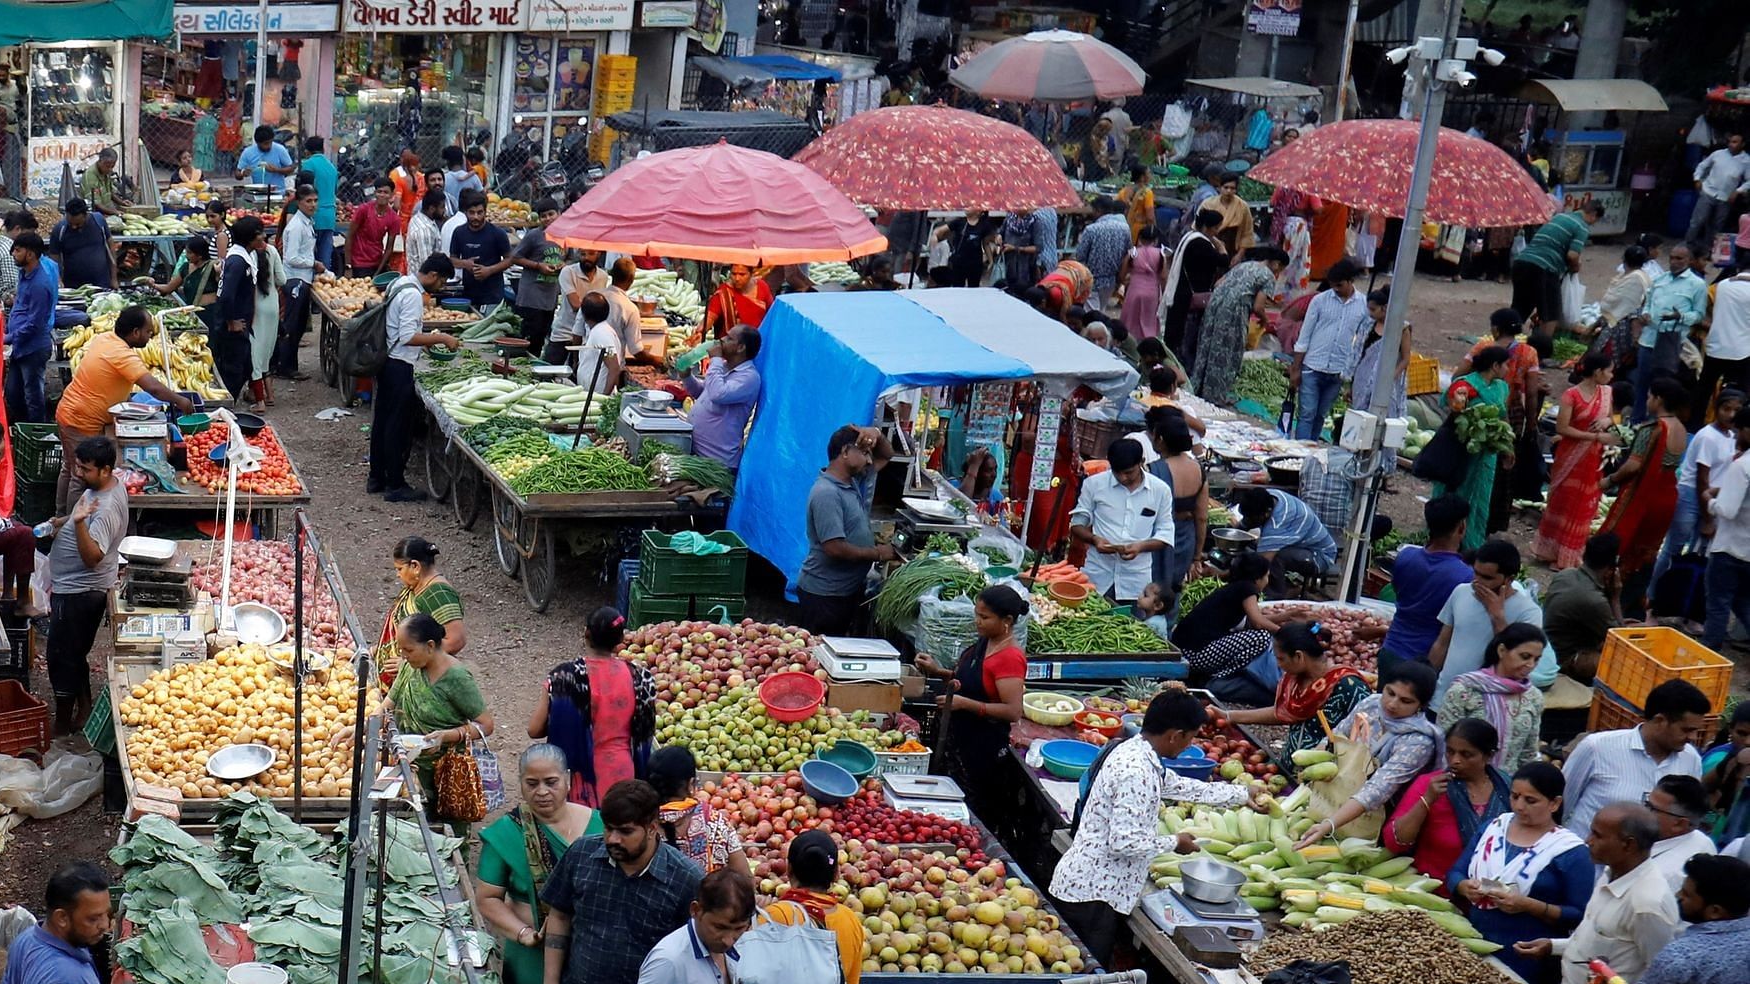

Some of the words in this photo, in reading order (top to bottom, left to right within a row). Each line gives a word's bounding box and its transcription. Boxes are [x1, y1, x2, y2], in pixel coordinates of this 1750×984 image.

[406, 0, 437, 26] ડેરી
[442, 0, 483, 26] સ્વીટ
[489, 0, 522, 25] માર્ટ
